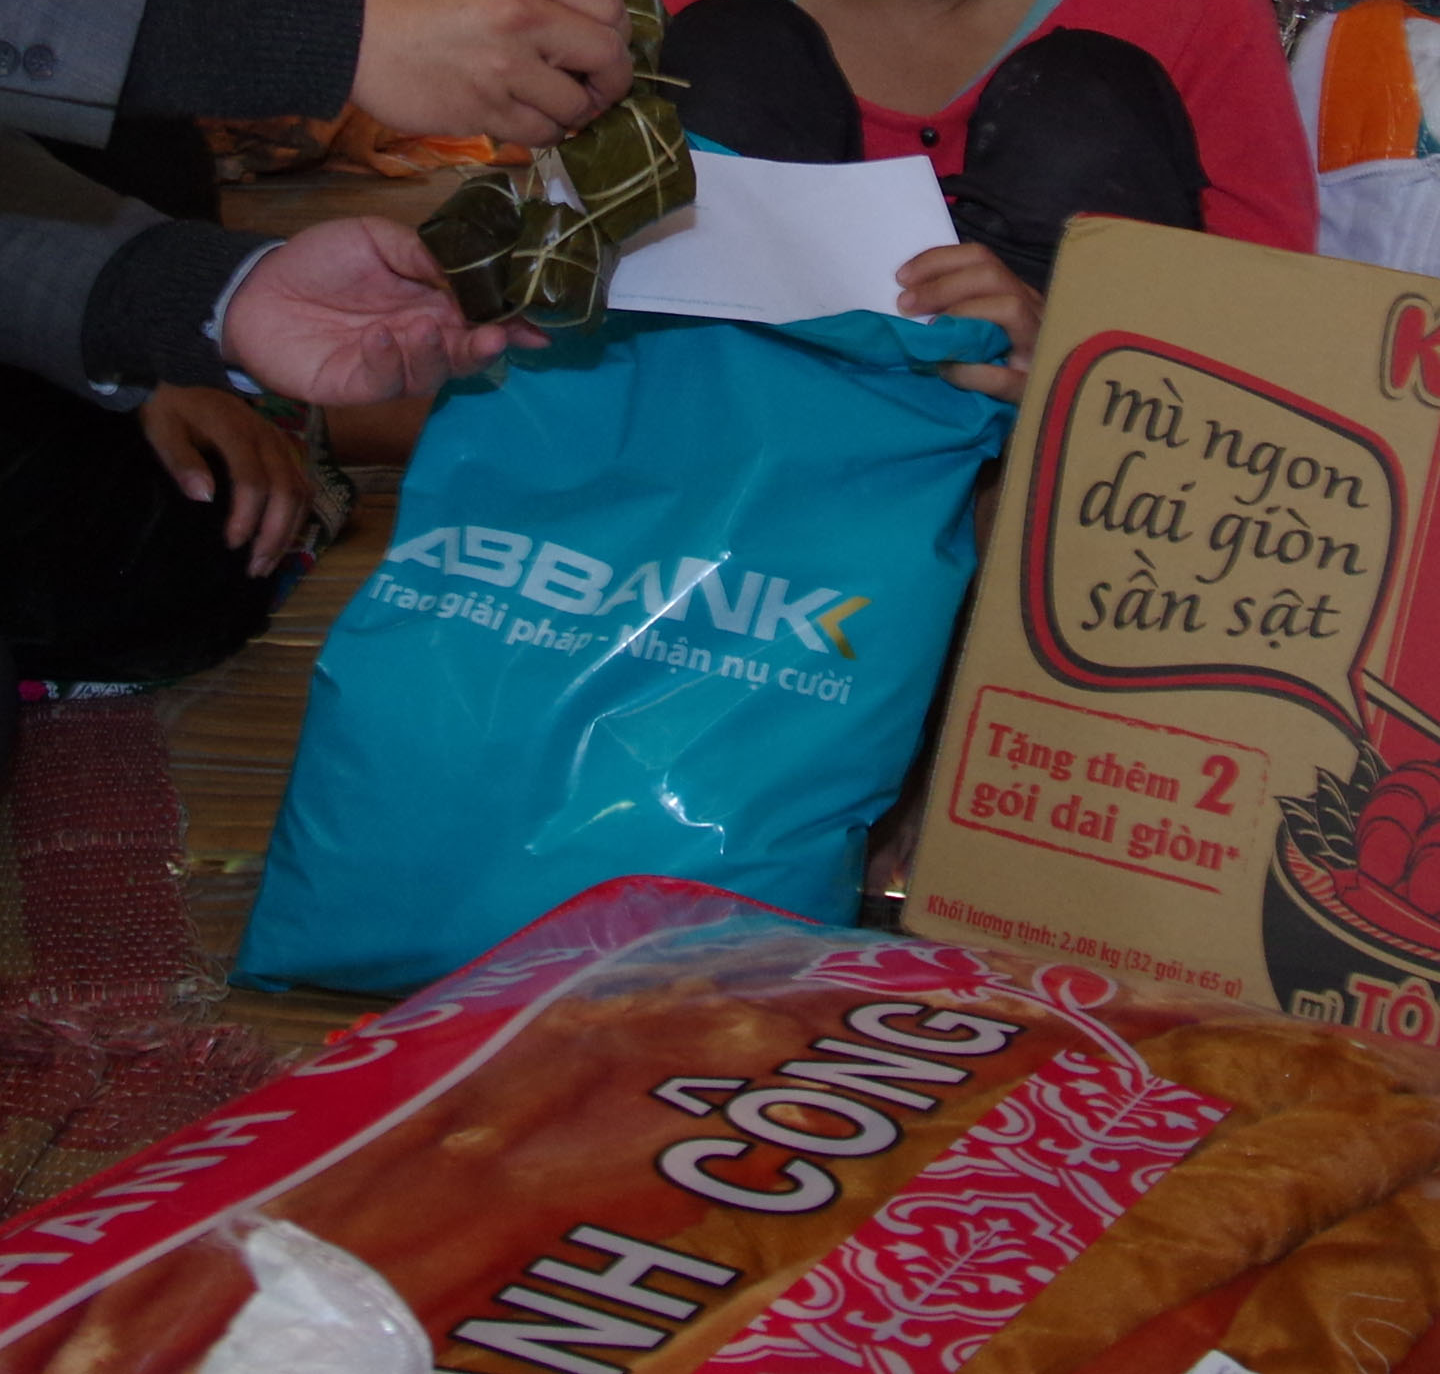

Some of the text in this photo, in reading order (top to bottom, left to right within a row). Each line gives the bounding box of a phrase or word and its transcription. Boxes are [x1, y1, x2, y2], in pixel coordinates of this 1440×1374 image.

[1102, 376, 1370, 510] mì ngon
[1078, 449, 1368, 585] dai giòn
[367, 573, 439, 612] Trao
[436, 591, 510, 631] giải
[504, 617, 594, 658] pháp
[616, 623, 713, 674] Nhận
[719, 654, 771, 690] nụ
[777, 666, 855, 706] cười
[386, 525, 844, 654] ABBANK
[1080, 547, 1342, 649] sần sật
[968, 781, 1042, 822] gói
[1049, 794, 1120, 844] dai
[988, 722, 1241, 816] Tặng thêm 2
[927, 894, 965, 923] Khối
[1059, 930, 1098, 955] 2,08
[1099, 941, 1123, 969] kg
[1123, 947, 1152, 974] (32
[1154, 958, 1185, 983] gói
[1198, 970, 1223, 992] 65
[1295, 989, 1342, 1024] mì
[435, 1001, 1026, 1374] NH CÔNG
